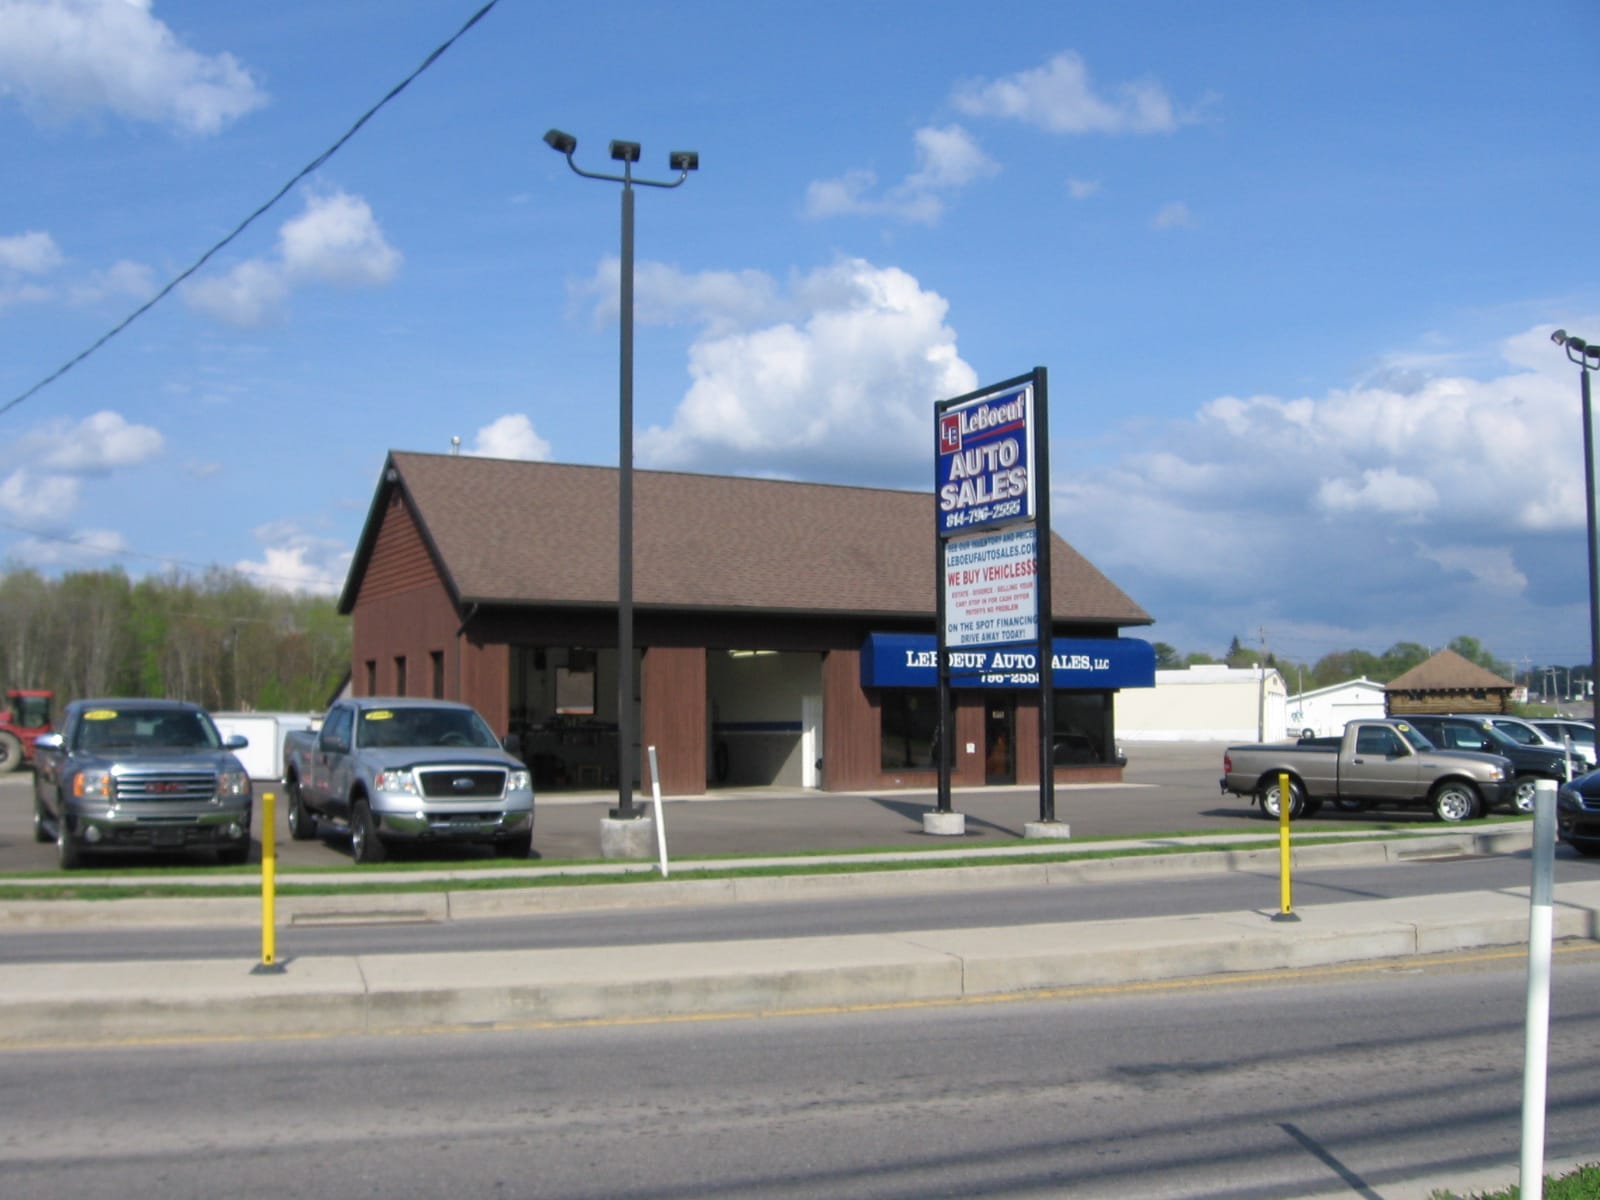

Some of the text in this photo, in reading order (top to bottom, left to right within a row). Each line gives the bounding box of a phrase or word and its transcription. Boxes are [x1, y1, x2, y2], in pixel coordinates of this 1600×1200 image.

[961, 395, 1025, 434] LeBoeuf
[949, 438, 1019, 480] AUTO
[940, 466, 1027, 511] SALES
[946, 500, 1021, 528] 814-796-2555
[948, 572, 960, 587] WE
[963, 568, 980, 585] BUY
[948, 623, 958, 633] ON
[960, 621, 974, 631] THE
[975, 619, 994, 630] SPOT
[961, 628, 1026, 643] DRIVE AWAY TODAY!
[991, 652, 1036, 669] AUTO
[1050, 655, 1094, 671] ALES,
[1094, 659, 1110, 670] LLC
